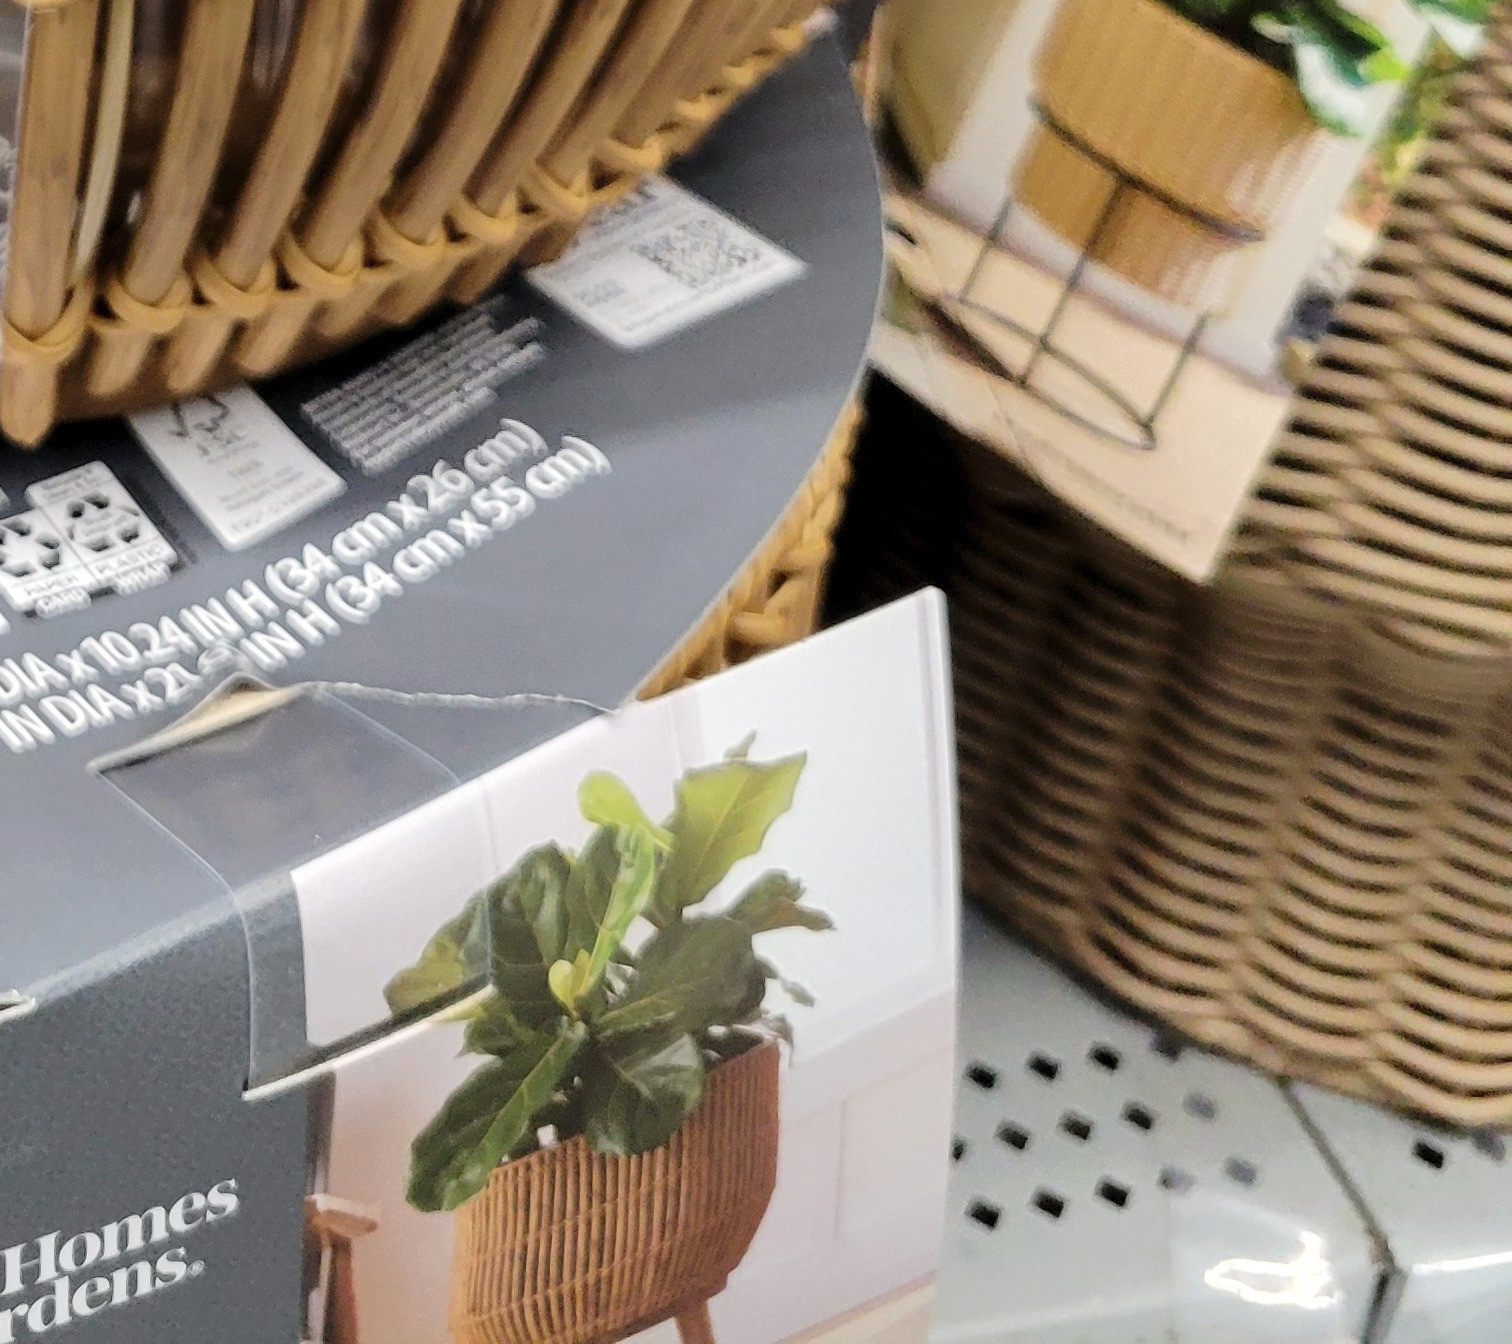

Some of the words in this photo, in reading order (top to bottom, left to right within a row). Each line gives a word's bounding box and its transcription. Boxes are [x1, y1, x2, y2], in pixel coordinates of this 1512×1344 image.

[462, 416, 550, 481] cm)
[523, 434, 613, 499] cm)
[387, 492, 432, 531] x
[404, 458, 477, 512] 26
[469, 474, 538, 532] 55
[332, 510, 405, 565] cm
[446, 509, 493, 547] x
[263, 542, 343, 604] (34
[392, 528, 468, 584] cm
[225, 578, 282, 629] H
[324, 559, 405, 625] (34
[80, 614, 199, 676] 10.24
[178, 596, 248, 650] IN
[238, 620, 307, 672] IN
[285, 598, 344, 646] H
[56, 647, 100, 685] x
[39, 682, 137, 738] DIA
[118, 677, 165, 714] x
